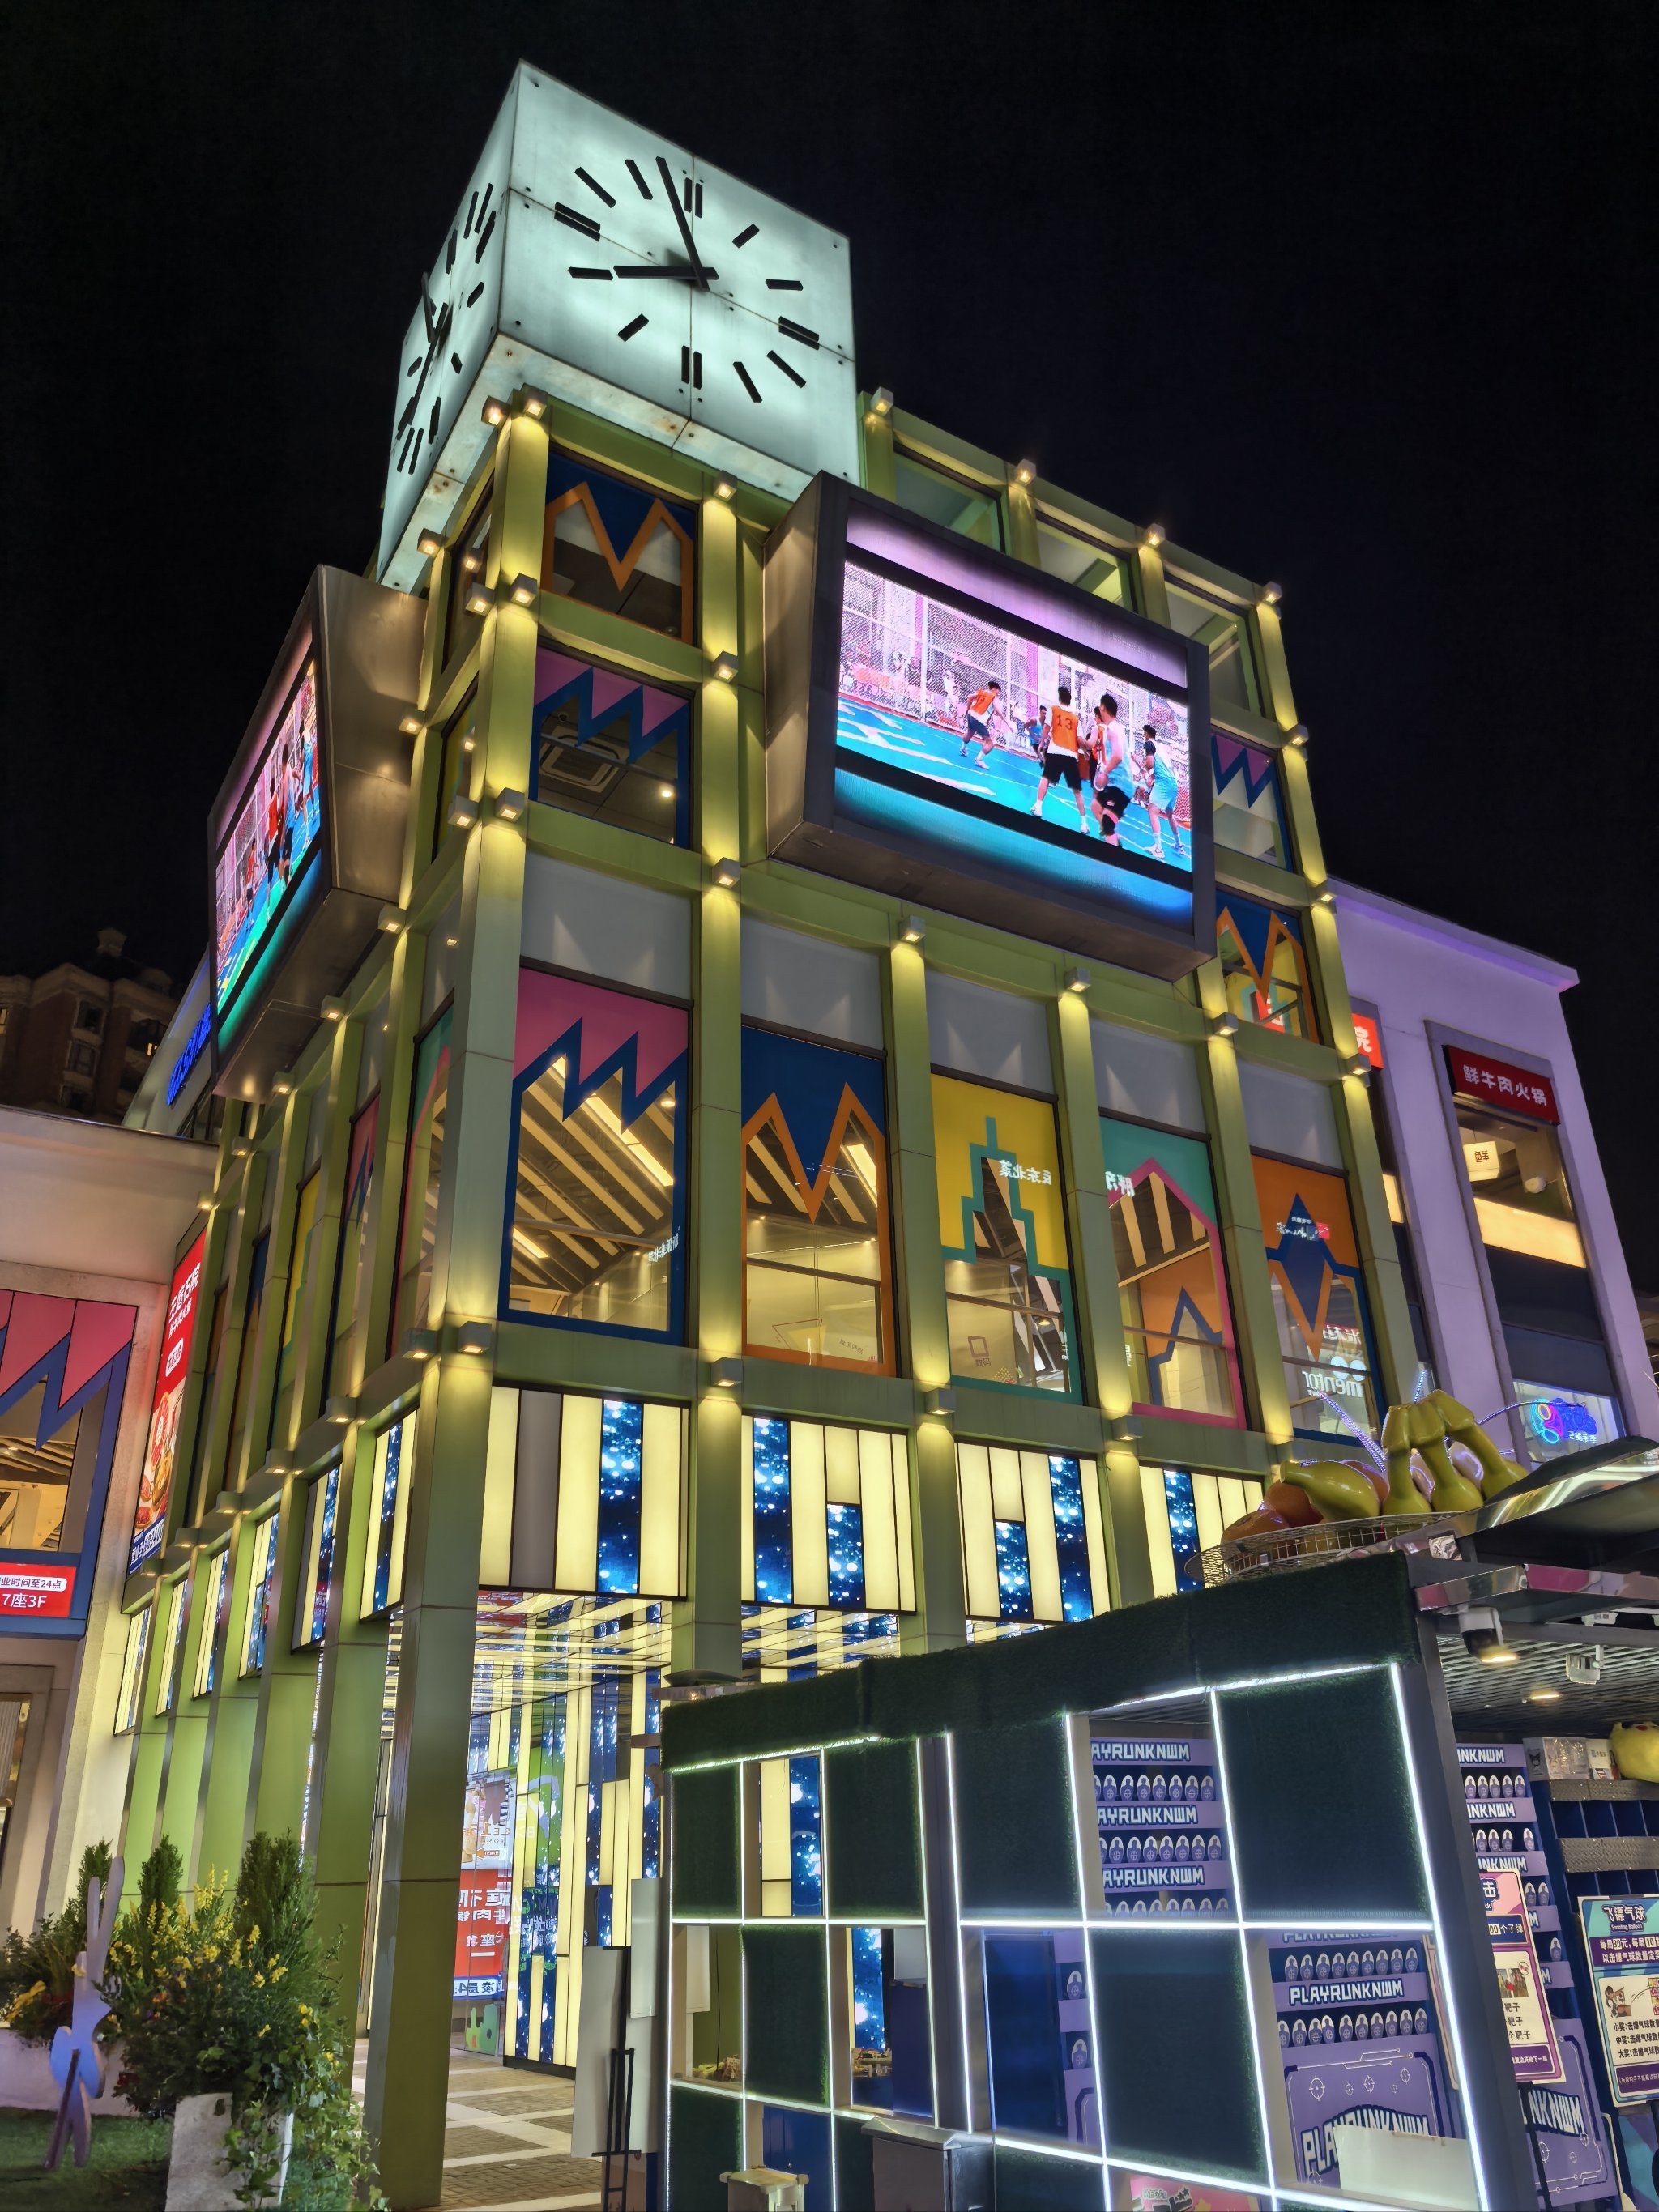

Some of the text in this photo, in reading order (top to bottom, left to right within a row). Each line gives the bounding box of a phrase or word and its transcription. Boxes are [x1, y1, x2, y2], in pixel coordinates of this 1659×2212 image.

[1056, 714, 1073, 730] 13
[1462, 1064, 1548, 1106] 鲜牛肉火锅
[1474, 1149, 1490, 1163] 鲜
[0, 1576, 62, 1589] 业时间至24点
[2, 1592, 47, 1609] 7座3F
[1482, 1880, 1496, 1898] 击
[1603, 1906, 1646, 1922] 飞镖气球
[1290, 1979, 1404, 2005] PLAYRUNKNWM
